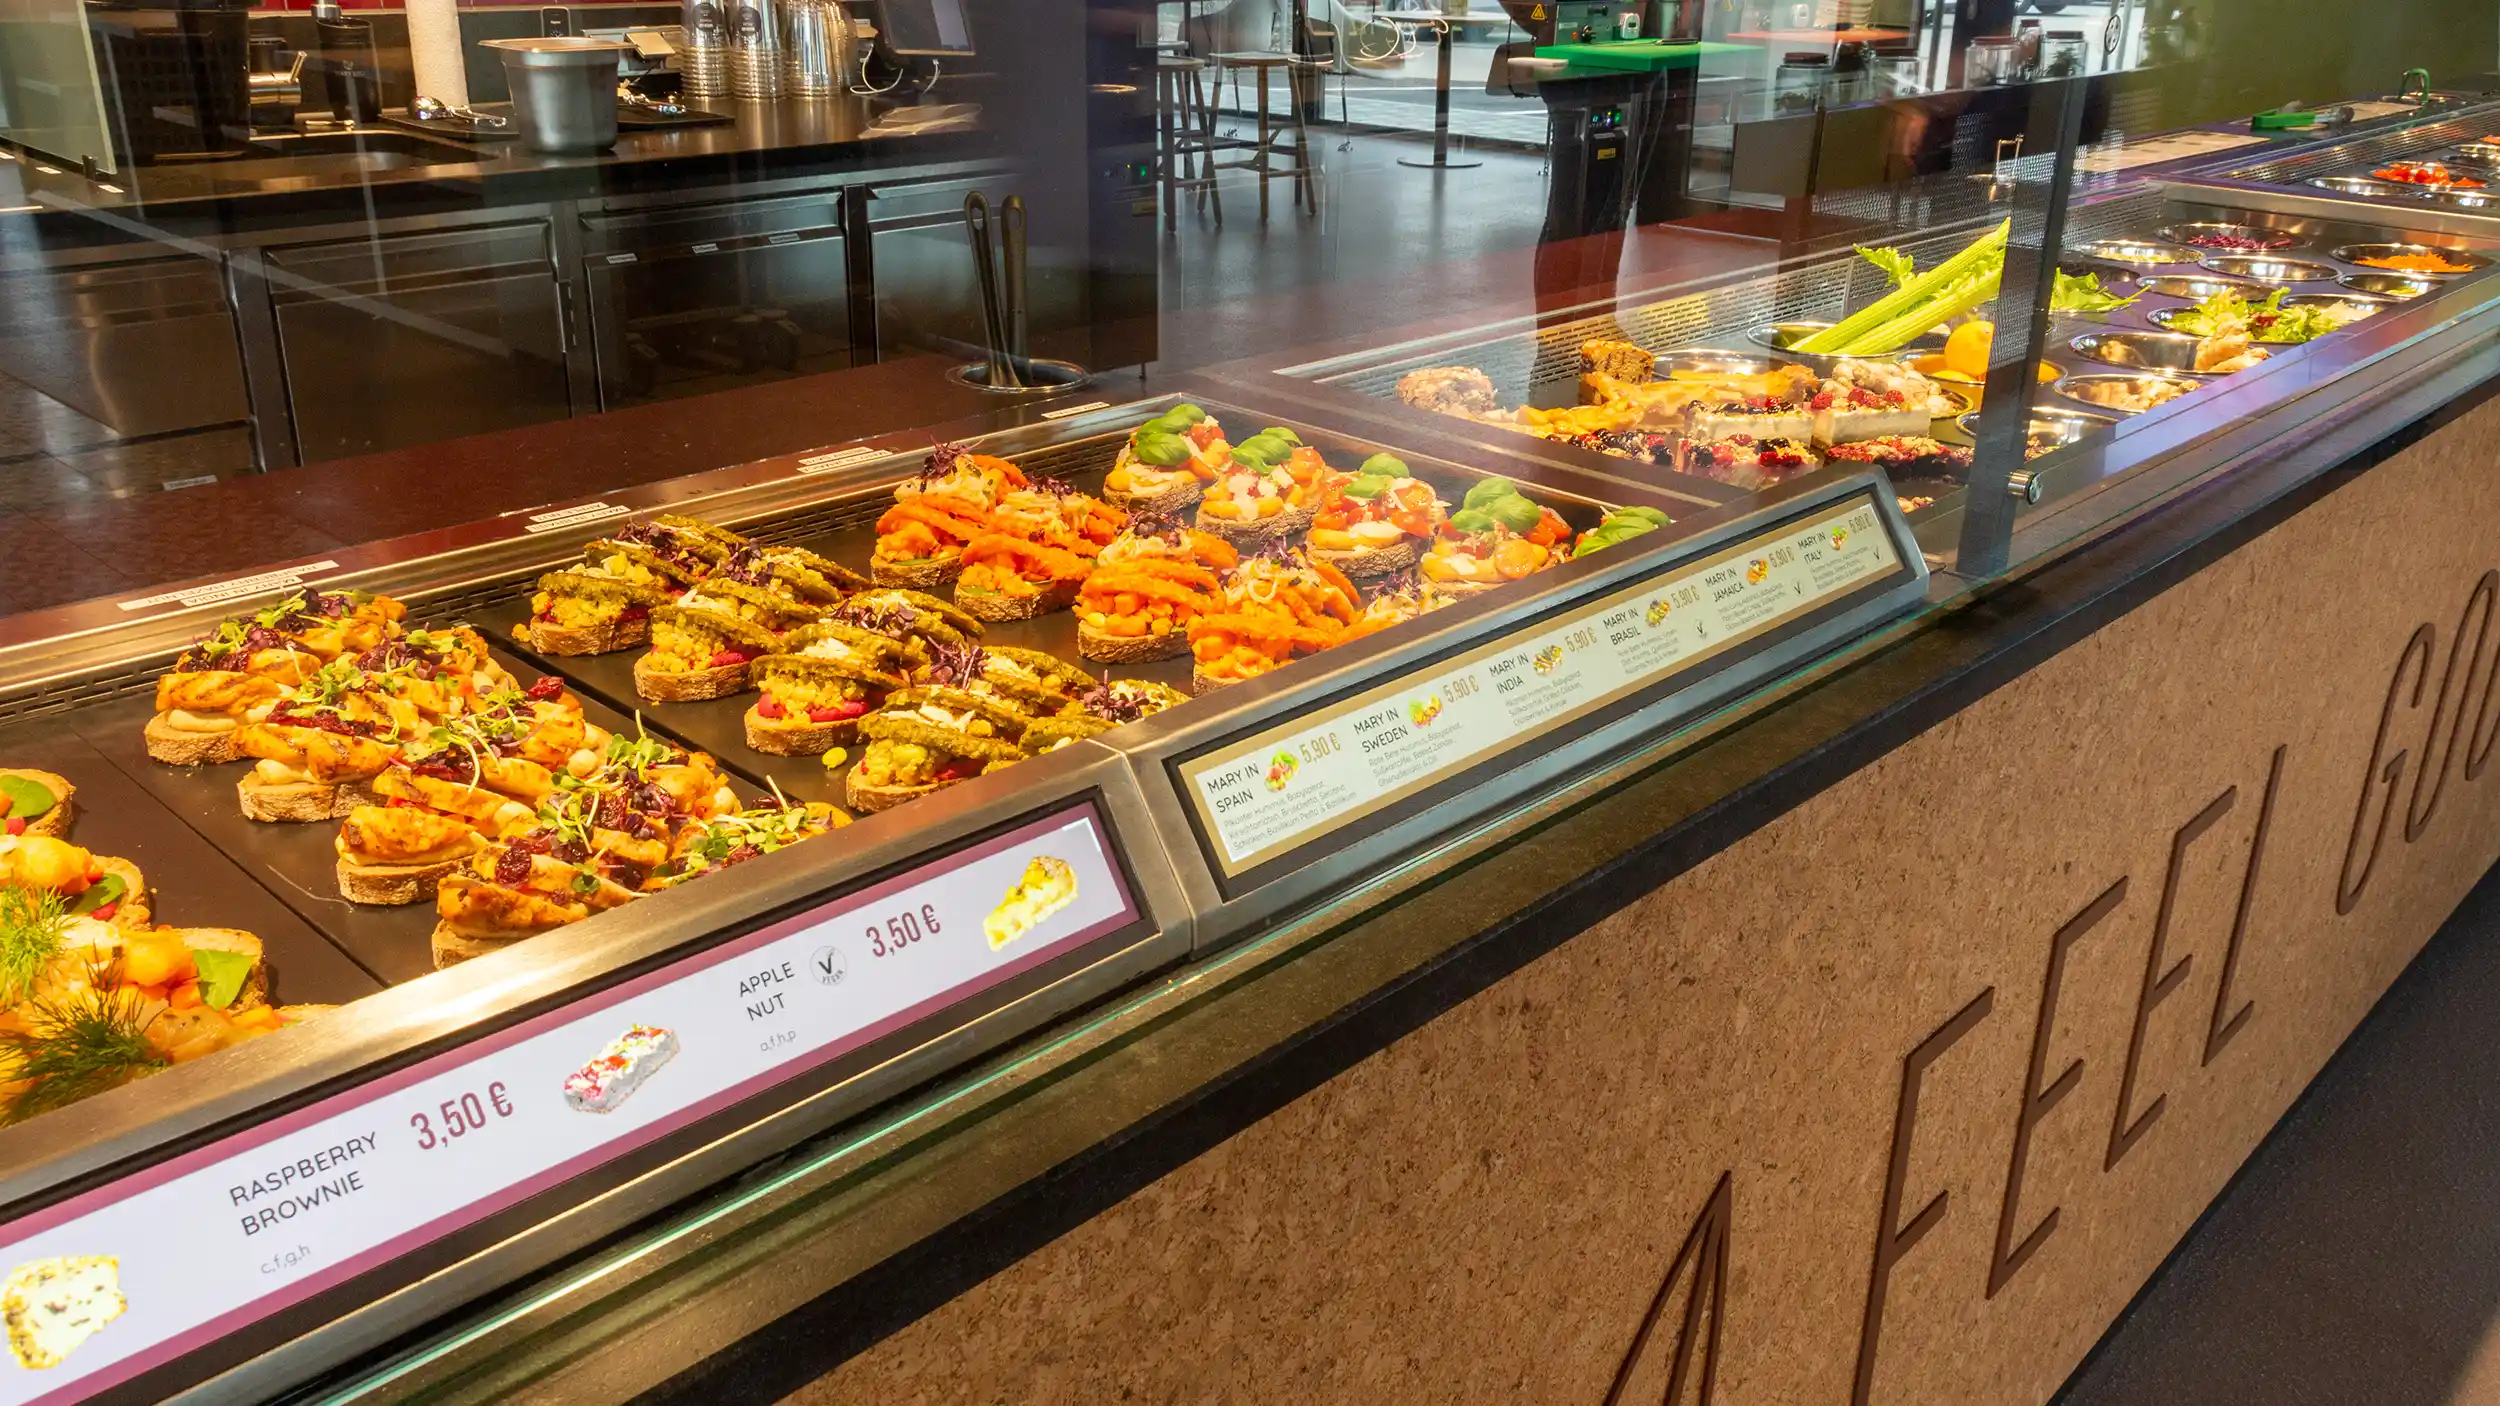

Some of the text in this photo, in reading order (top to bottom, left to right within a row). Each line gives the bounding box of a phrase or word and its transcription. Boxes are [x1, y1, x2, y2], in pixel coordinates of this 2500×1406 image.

[1798, 532, 1826, 549] MARY IN
[1804, 550, 1822, 564] ITALY
[1705, 568, 1737, 587] MARY IN
[1714, 582, 1744, 603] JAMAICA
[1603, 608, 1639, 629] MARY IN
[1565, 630, 1590, 652] 5,90
[1587, 627, 1597, 644] €
[1610, 626, 1641, 645] BRASIL
[1489, 653, 1529, 676] MARY IN
[1470, 675, 1479, 692] €
[1497, 676, 1524, 694] INDIA
[1354, 708, 1399, 735] MARY IN
[1299, 732, 1341, 764] 5,90 €
[1362, 725, 1408, 753] SWEDEN
[1207, 763, 1259, 794] MARY IN
[1216, 789, 1253, 813] SPAIN
[866, 904, 941, 957] 3,50 €
[740, 962, 795, 997] APPLE
[747, 993, 784, 1021] NUT
[1853, 743, 2287, 1406] FEEL
[411, 1082, 513, 1150] 3,50 €
[230, 1132, 375, 1207] RASPBERRY
[241, 1171, 364, 1236] BROWNIE
